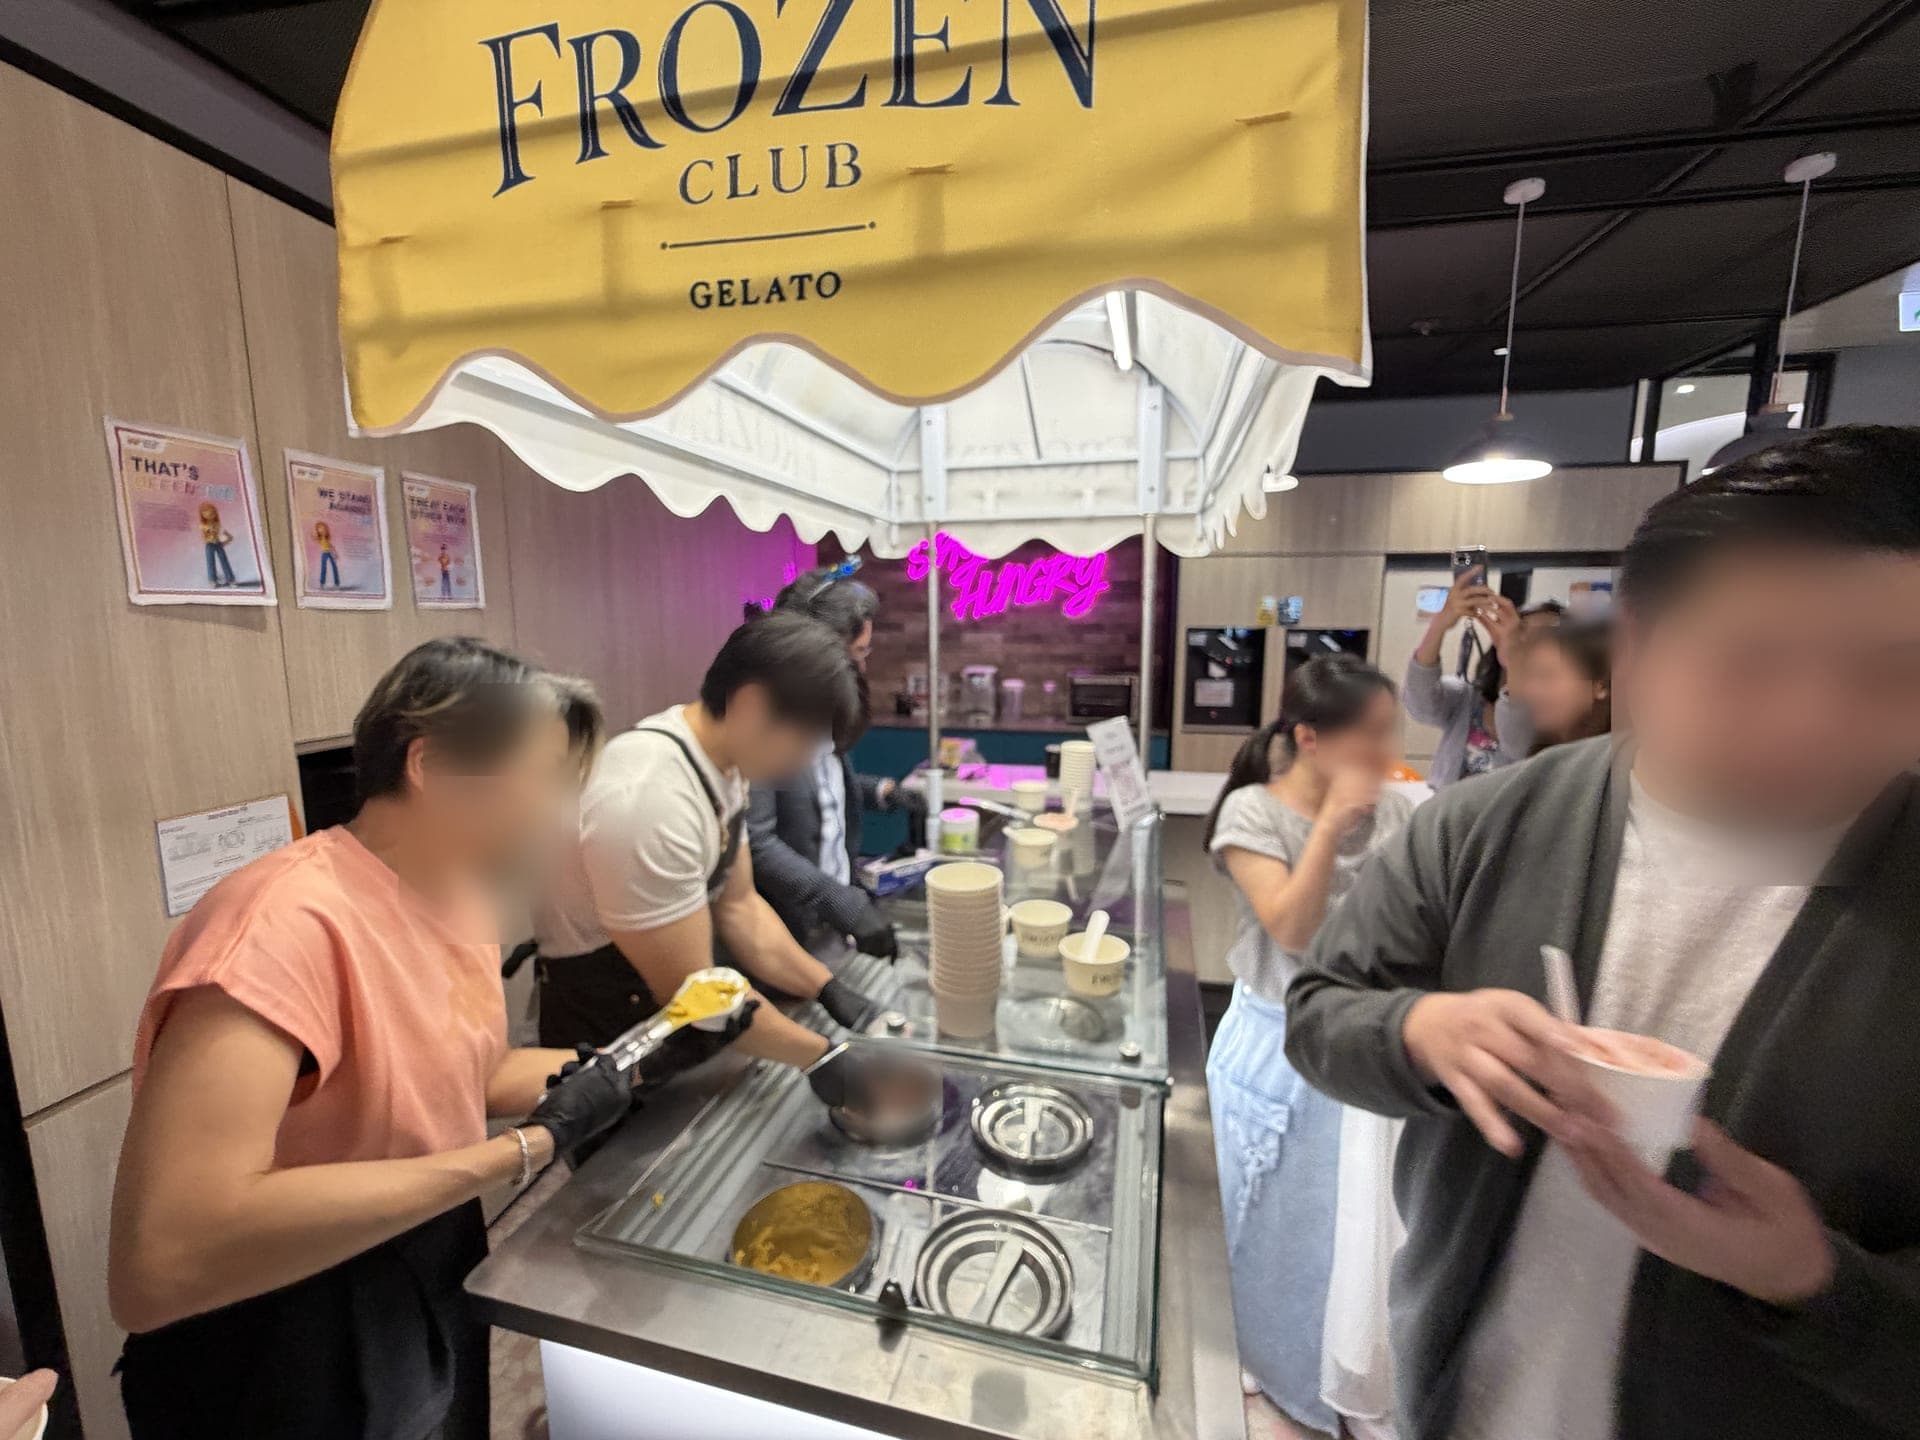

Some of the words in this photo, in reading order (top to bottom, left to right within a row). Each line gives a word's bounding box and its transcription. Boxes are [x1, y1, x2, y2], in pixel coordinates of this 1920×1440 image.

[478, 0, 1098, 199] FROZEN
[678, 141, 863, 205] CLUB
[689, 271, 843, 310] GELATO
[130, 456, 199, 481] THAT'S
